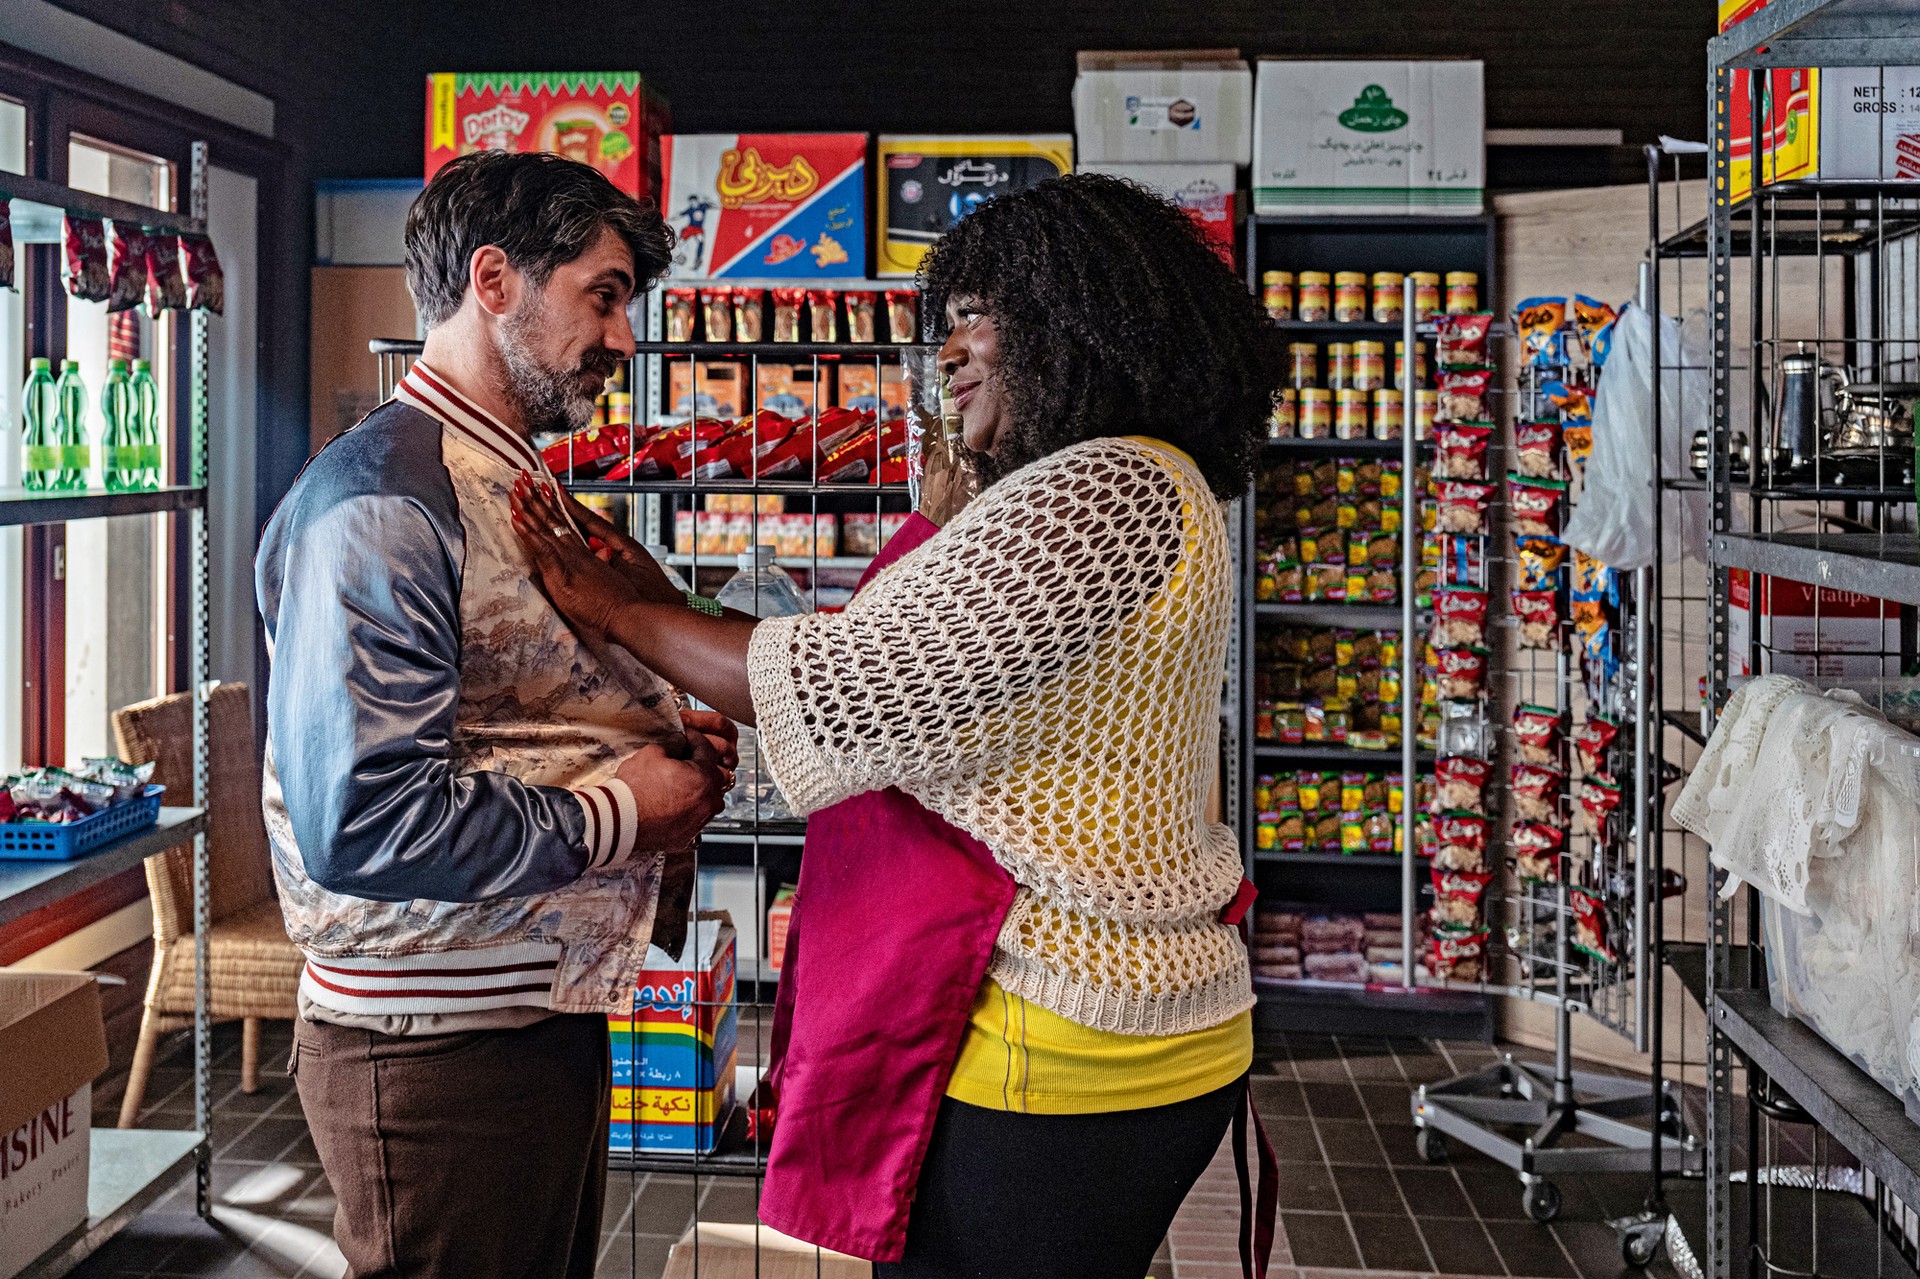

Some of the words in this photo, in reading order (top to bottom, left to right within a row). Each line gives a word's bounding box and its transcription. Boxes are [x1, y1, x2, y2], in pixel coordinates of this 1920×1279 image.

[464, 105, 529, 142] Derby
[1800, 585, 1870, 607] Vtatips
[634, 977, 695, 1021] إندو
[611, 1094, 649, 1110] خضا
[652, 1095, 691, 1117] نكهة
